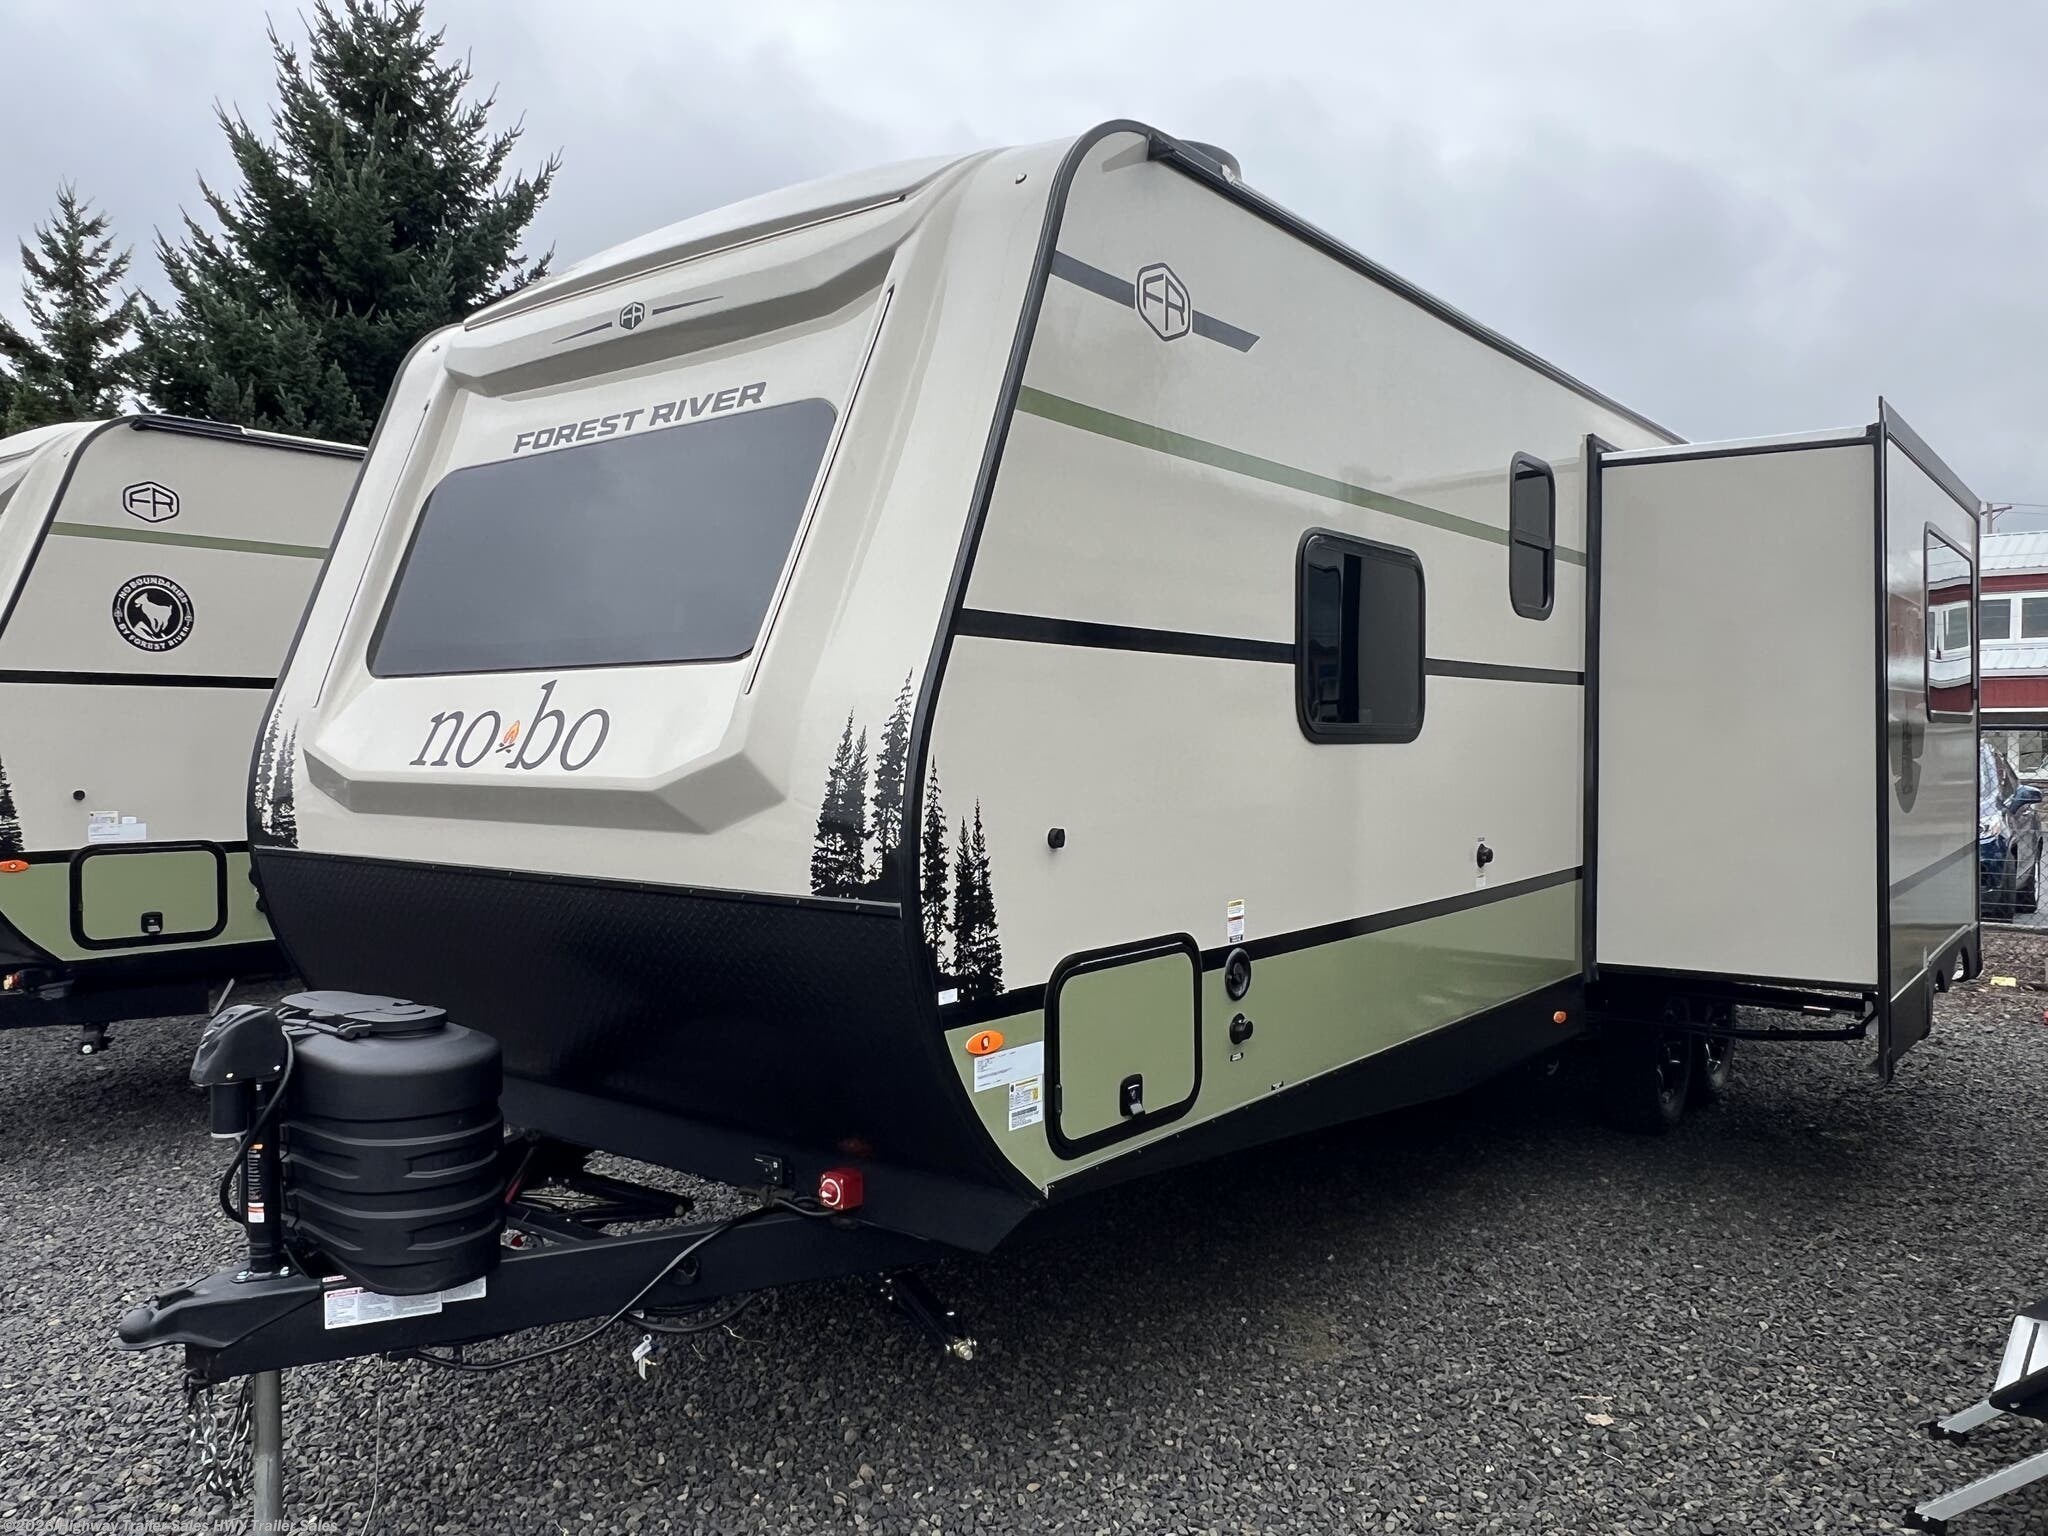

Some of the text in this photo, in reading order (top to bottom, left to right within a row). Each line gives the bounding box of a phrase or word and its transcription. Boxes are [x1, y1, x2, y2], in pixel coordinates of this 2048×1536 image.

[513, 381, 767, 454] FOREST RIVER
[129, 487, 174, 518] FR
